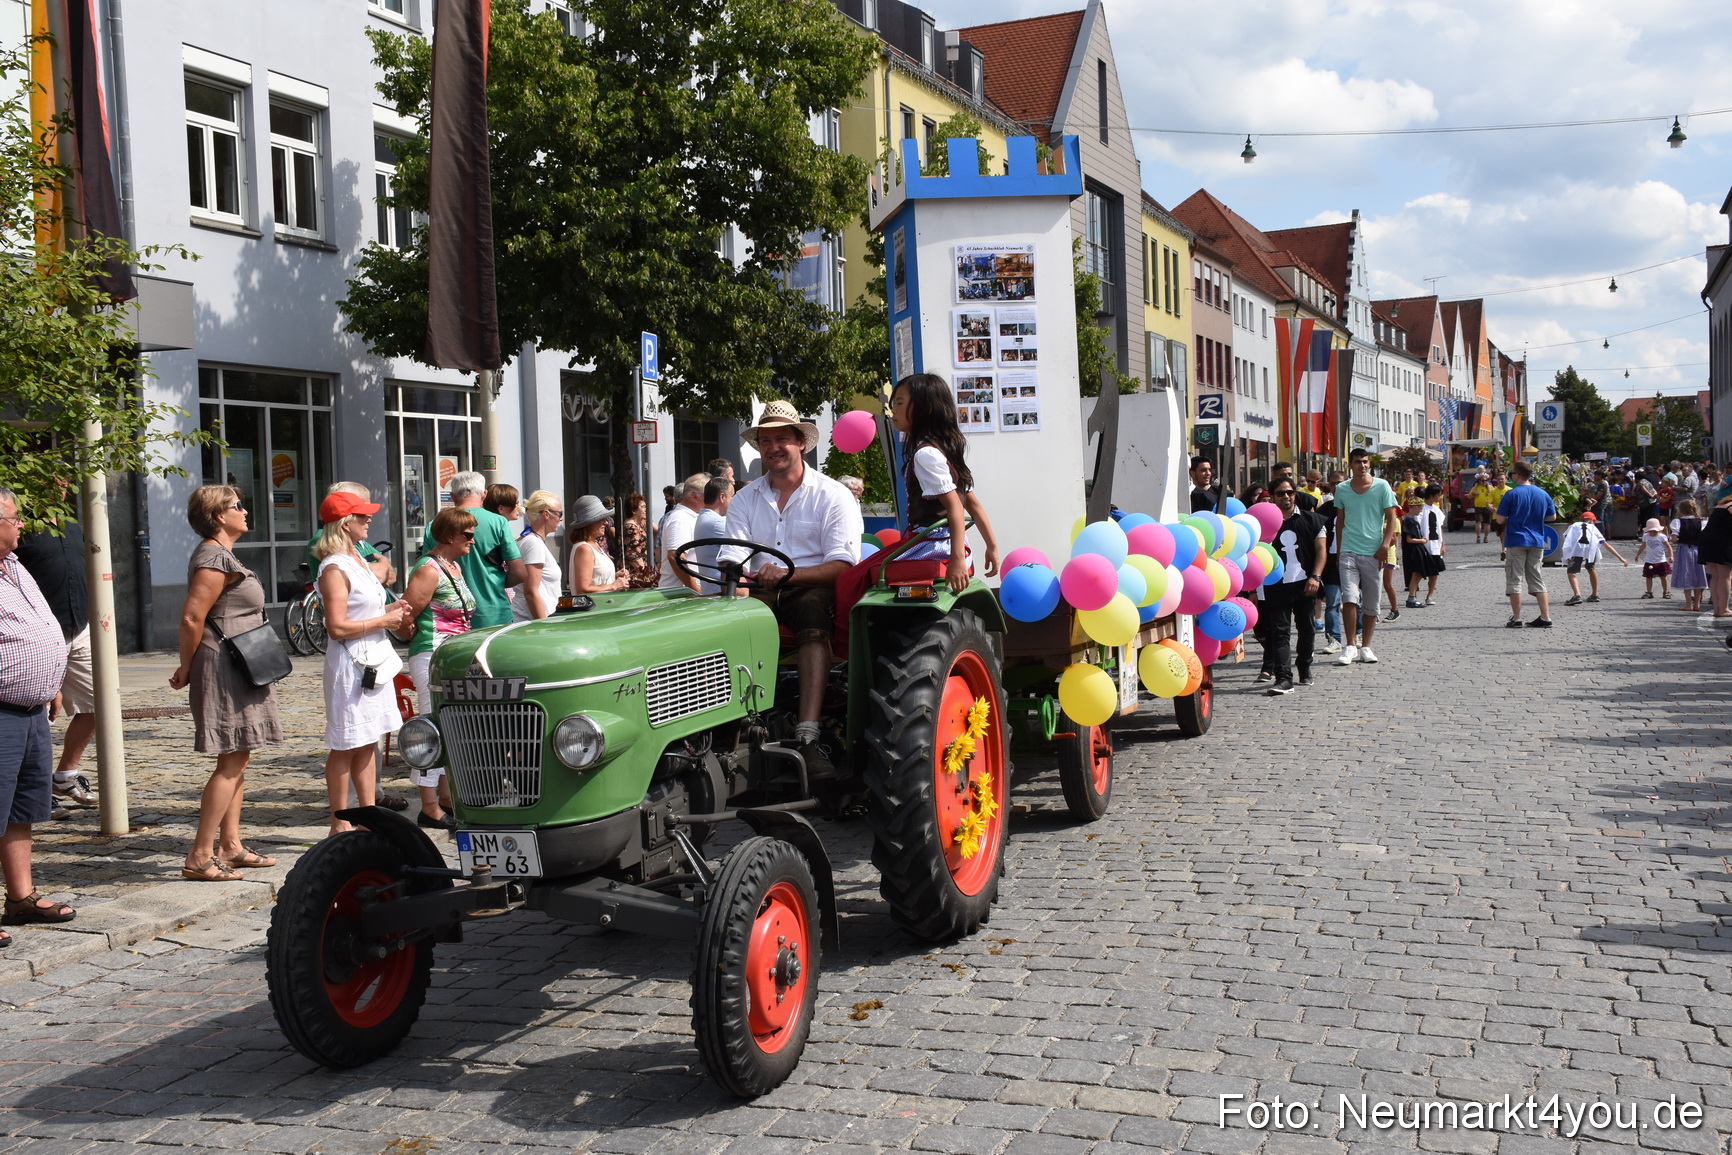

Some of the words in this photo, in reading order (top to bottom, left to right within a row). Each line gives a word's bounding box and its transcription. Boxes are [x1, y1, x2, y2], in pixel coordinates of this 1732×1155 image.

[646, 339, 654, 373] P
[441, 678, 526, 700] FENDT
[472, 834, 499, 852] NM
[505, 856, 529, 874] 63
